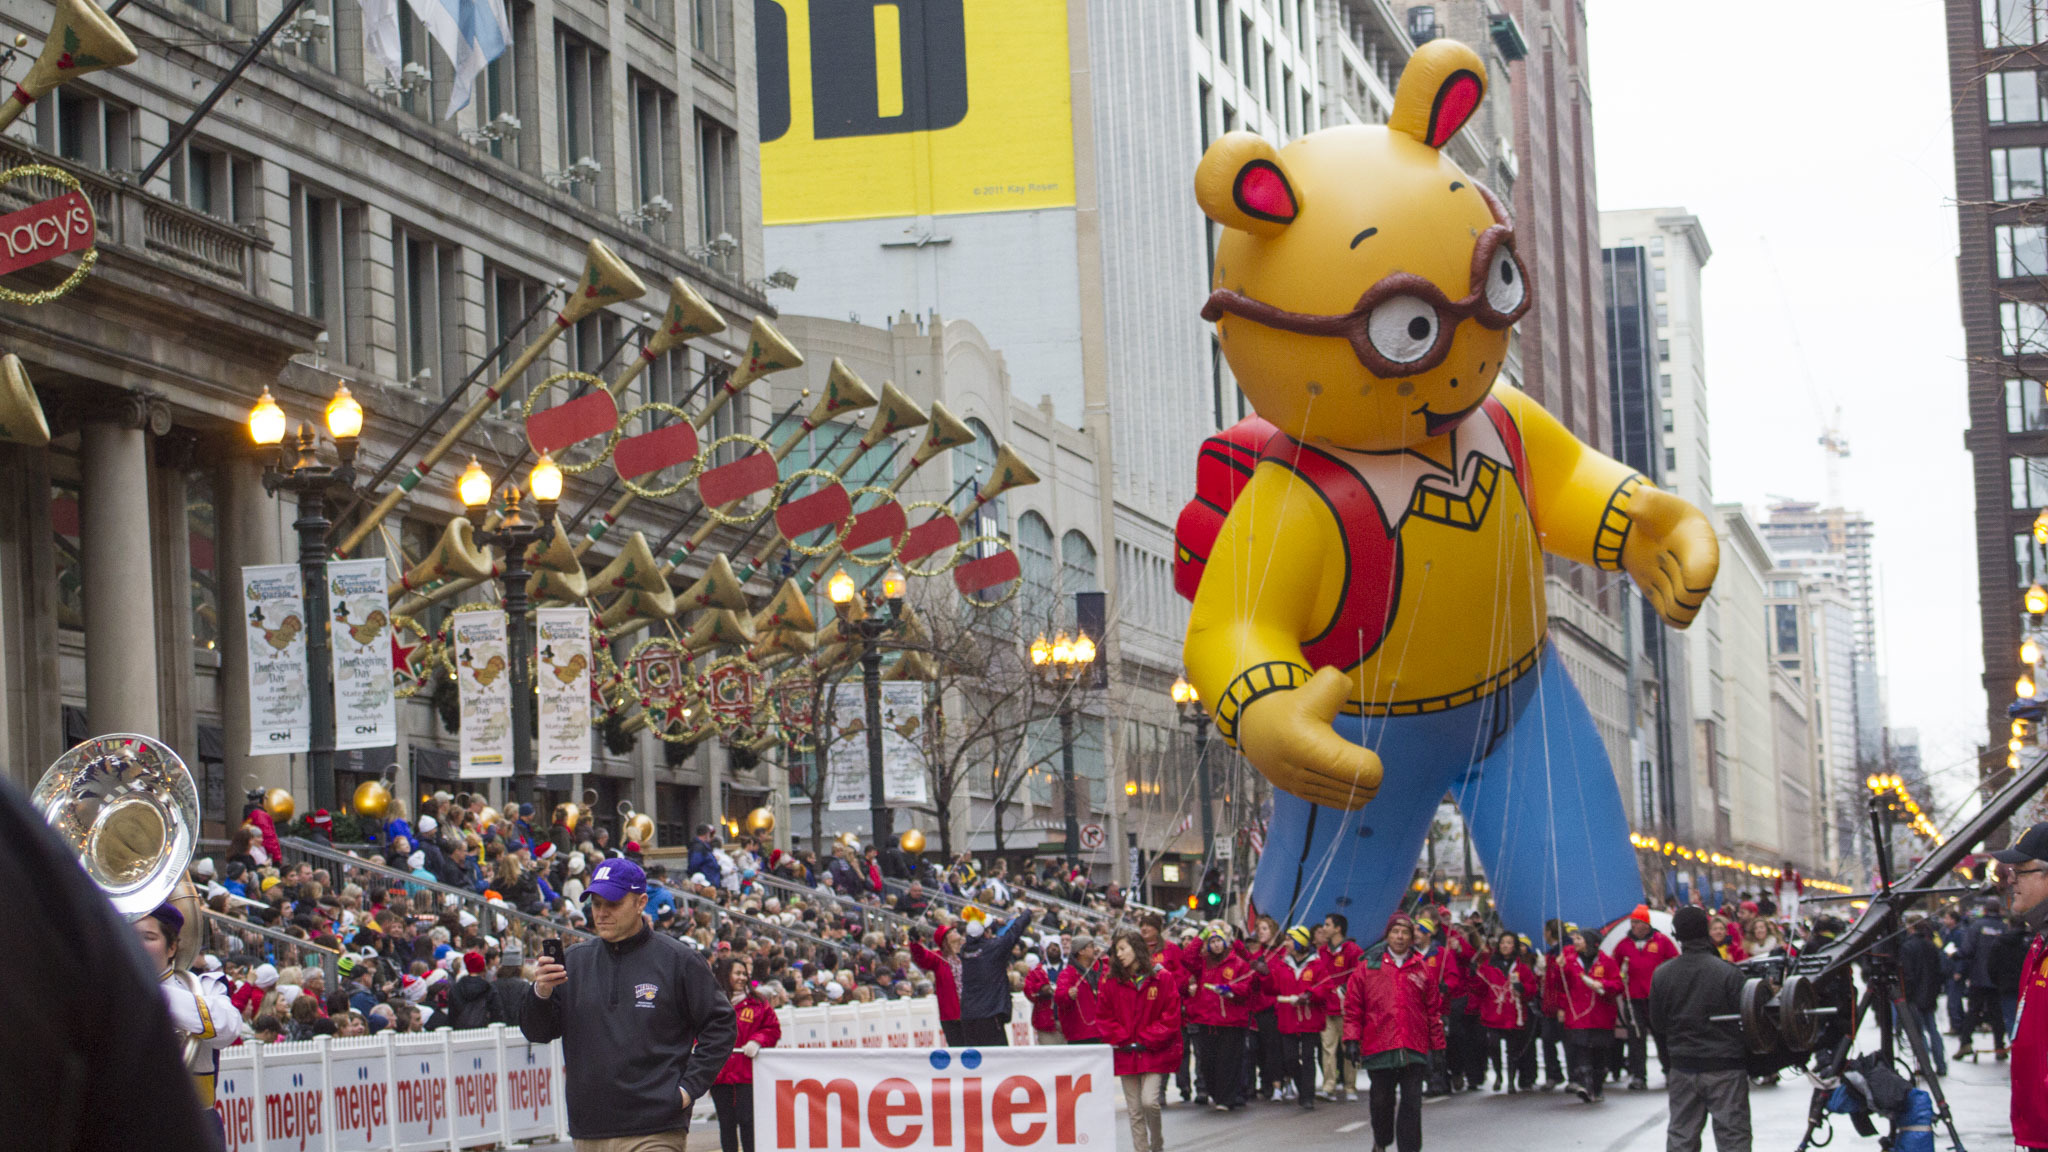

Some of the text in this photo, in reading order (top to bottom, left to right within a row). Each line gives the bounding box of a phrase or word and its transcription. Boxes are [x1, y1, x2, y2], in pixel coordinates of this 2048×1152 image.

[755, 0, 968, 143] D
[254, 661, 302, 673] Thanksgiving
[269, 674, 286, 683] Day
[339, 656, 387, 669] Thanksgiving
[354, 669, 371, 679] Day
[265, 1073, 323, 1152] meijer
[334, 1067, 388, 1143] meijer
[397, 1062, 447, 1135] meijer
[455, 1057, 497, 1128] meijer
[508, 1053, 552, 1121] meijer
